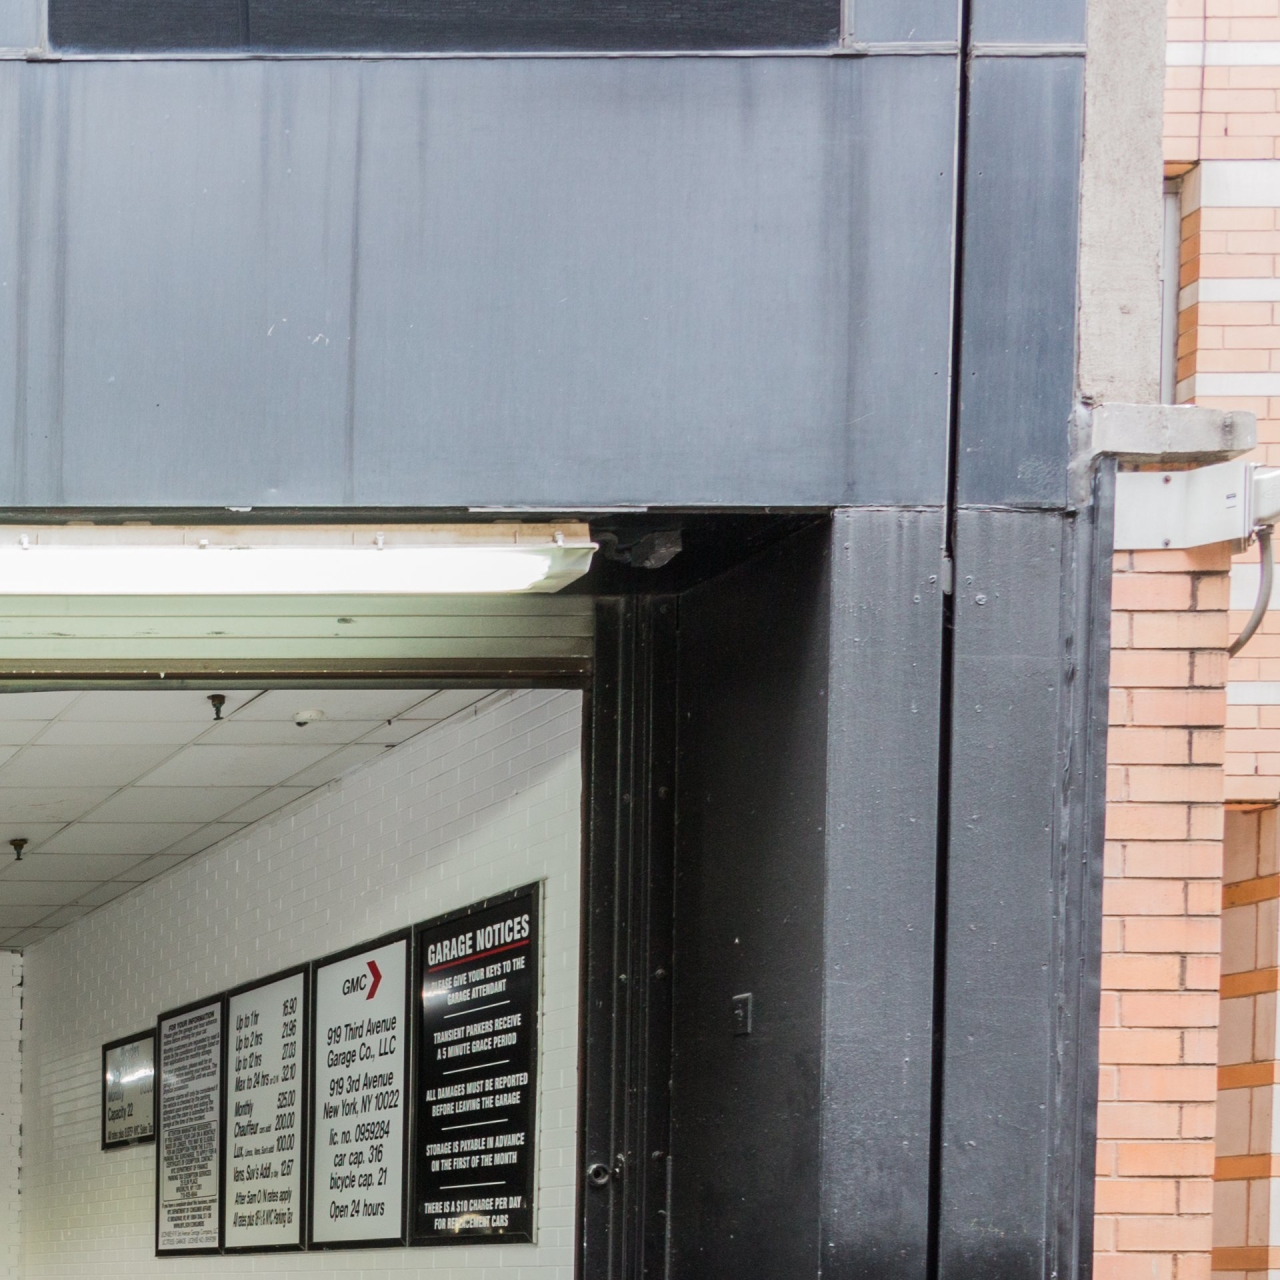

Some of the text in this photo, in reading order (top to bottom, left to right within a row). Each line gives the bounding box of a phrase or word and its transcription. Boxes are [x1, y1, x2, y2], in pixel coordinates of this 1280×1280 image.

[428, 914, 529, 966] GARAGE NOTICES
[342, 974, 367, 996] GMC
[431, 956, 526, 990] PLEASE GIVE YOUR KEYS TO THE
[447, 979, 507, 1005] GARAGE ATTENDANT
[327, 1016, 397, 1046] 919 Third Avenue
[433, 1013, 522, 1044] TRANSIENT PARKERS RECEIVE
[327, 1049, 356, 1068] Garage
[378, 1035, 397, 1057] LLC
[448, 1042, 471, 1058] MINUTE
[471, 1037, 492, 1053] GRACE
[493, 1032, 517, 1049] PERIOD
[329, 1071, 394, 1097] 919 3rd Avenue
[426, 1072, 528, 1101] ALL DAMAGES MUST BE REPORTED
[323, 1089, 400, 1120] New York, NY 10022
[432, 1091, 521, 1117] BEFORE LEAVING THE GARAGE
[341, 1130, 352, 1144] no.
[355, 1120, 391, 1142] 0959284
[426, 1132, 525, 1156] STORAGE IS PAYABLE IN ADVANCE
[333, 1144, 383, 1168] car cap. 316
[431, 1151, 518, 1172] ON THE FIRST OF THE MONTH
[329, 1167, 388, 1193] bicycle cap. 21
[329, 1199, 385, 1222] Open 24 hours
[424, 1196, 522, 1214] THERE IS A $10 CHARGE PER DAY
[434, 1218, 446, 1230] FOR
[492, 1214, 509, 1227] CARS
